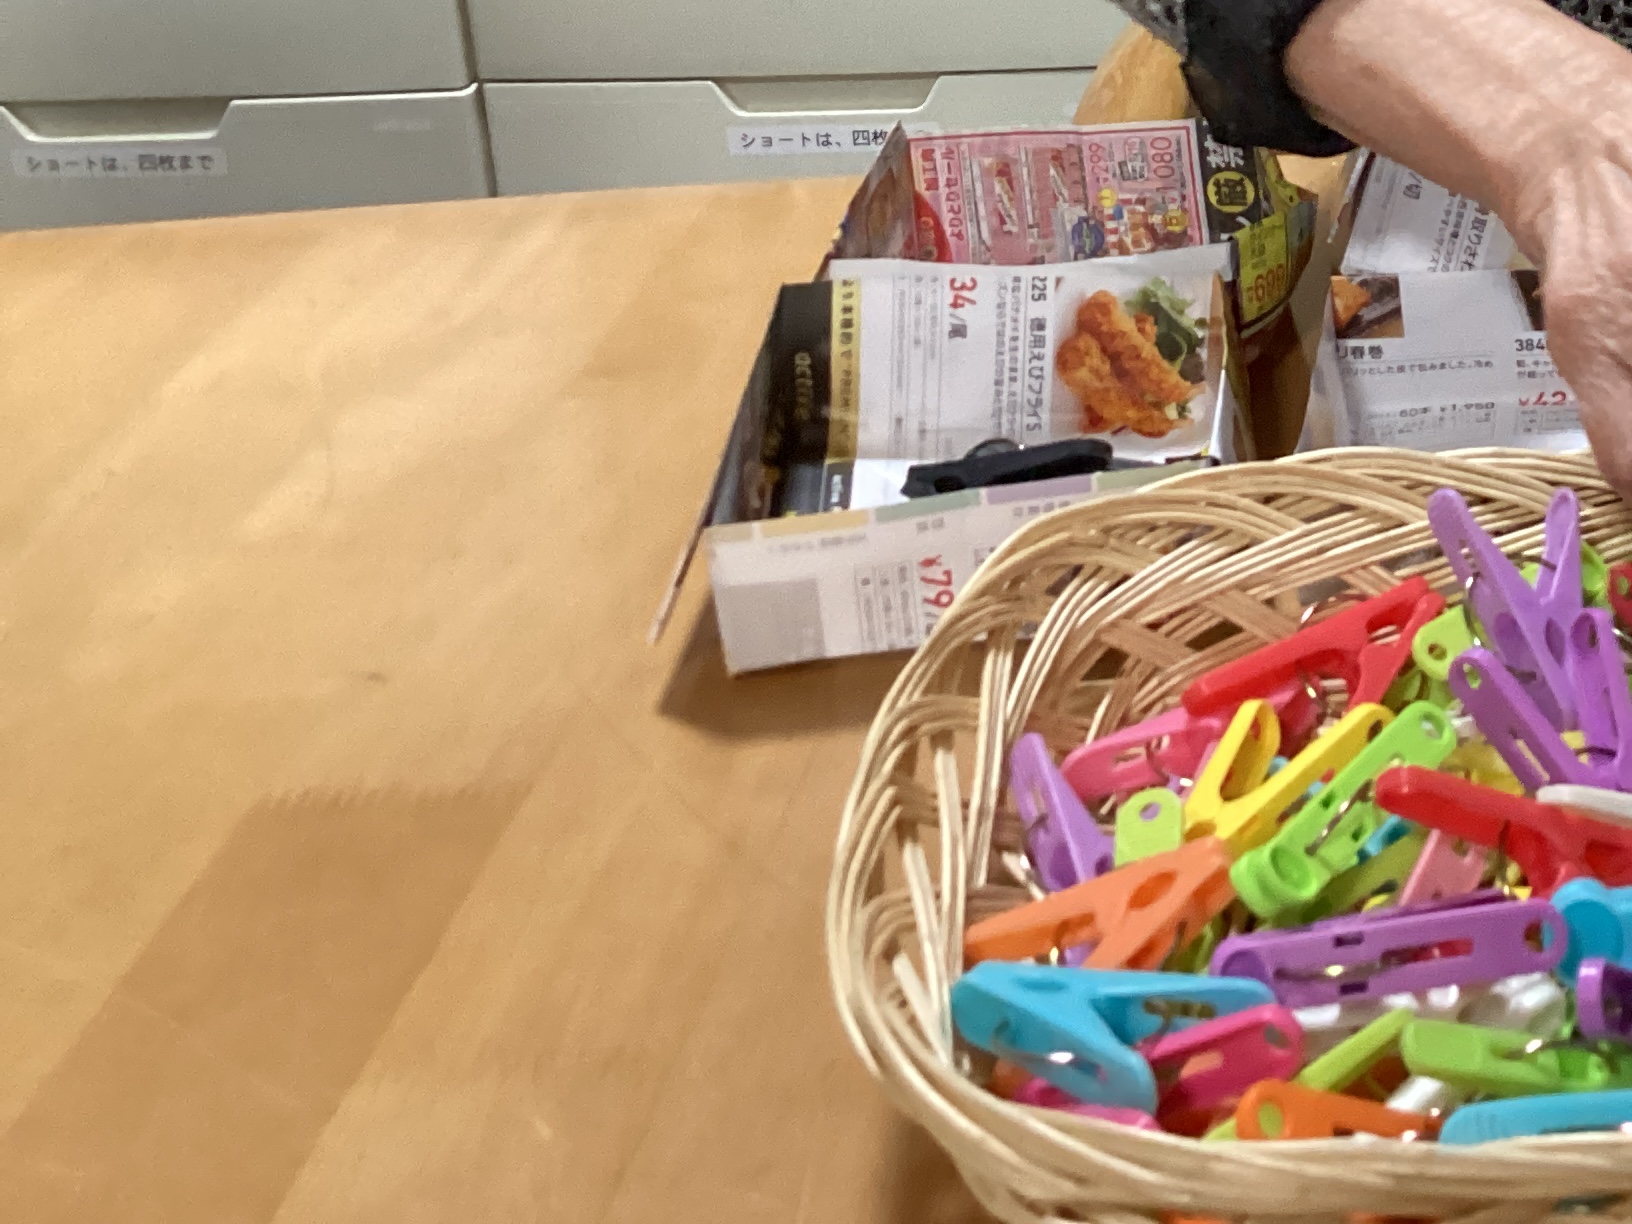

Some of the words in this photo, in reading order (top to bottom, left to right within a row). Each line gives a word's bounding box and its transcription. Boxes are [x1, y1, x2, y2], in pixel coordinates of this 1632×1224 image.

[26, 154, 216, 173] ショートは、四枚まで
[1514, 338, 1546, 353] 384
